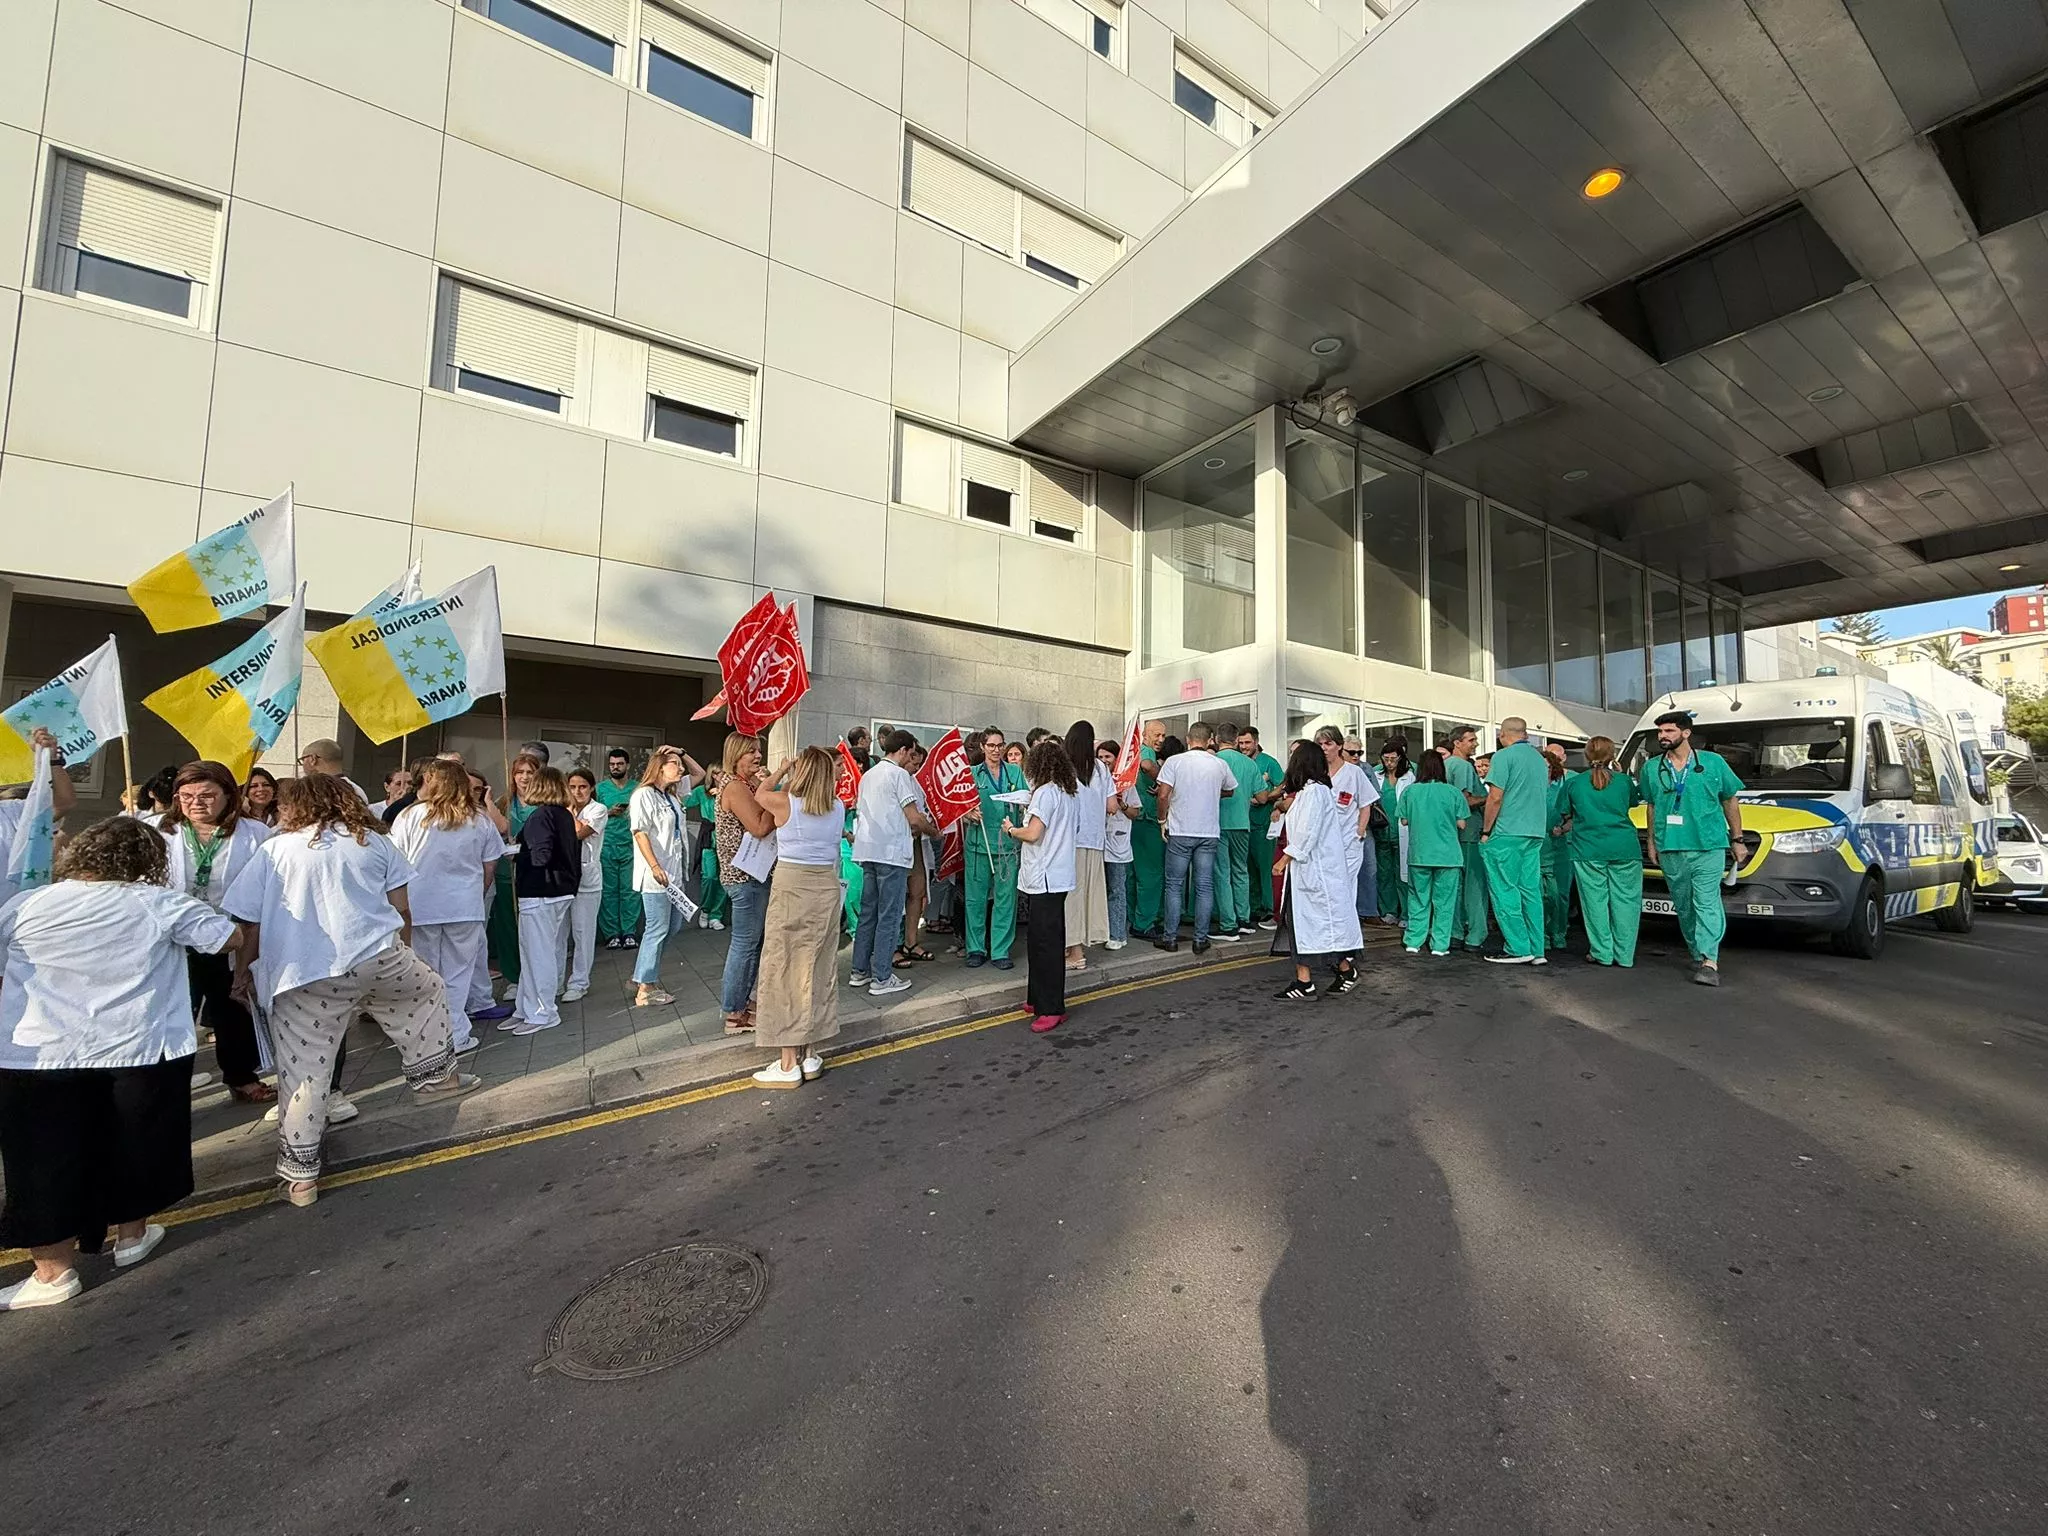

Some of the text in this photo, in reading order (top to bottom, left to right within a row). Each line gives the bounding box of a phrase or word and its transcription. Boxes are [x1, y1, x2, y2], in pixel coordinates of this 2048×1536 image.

[1792, 699, 1837, 707] 1119
[935, 745, 967, 785] UGT
[1738, 798, 1777, 806] MA
[667, 886, 678, 897] op
[1750, 905, 1771, 914] SP
